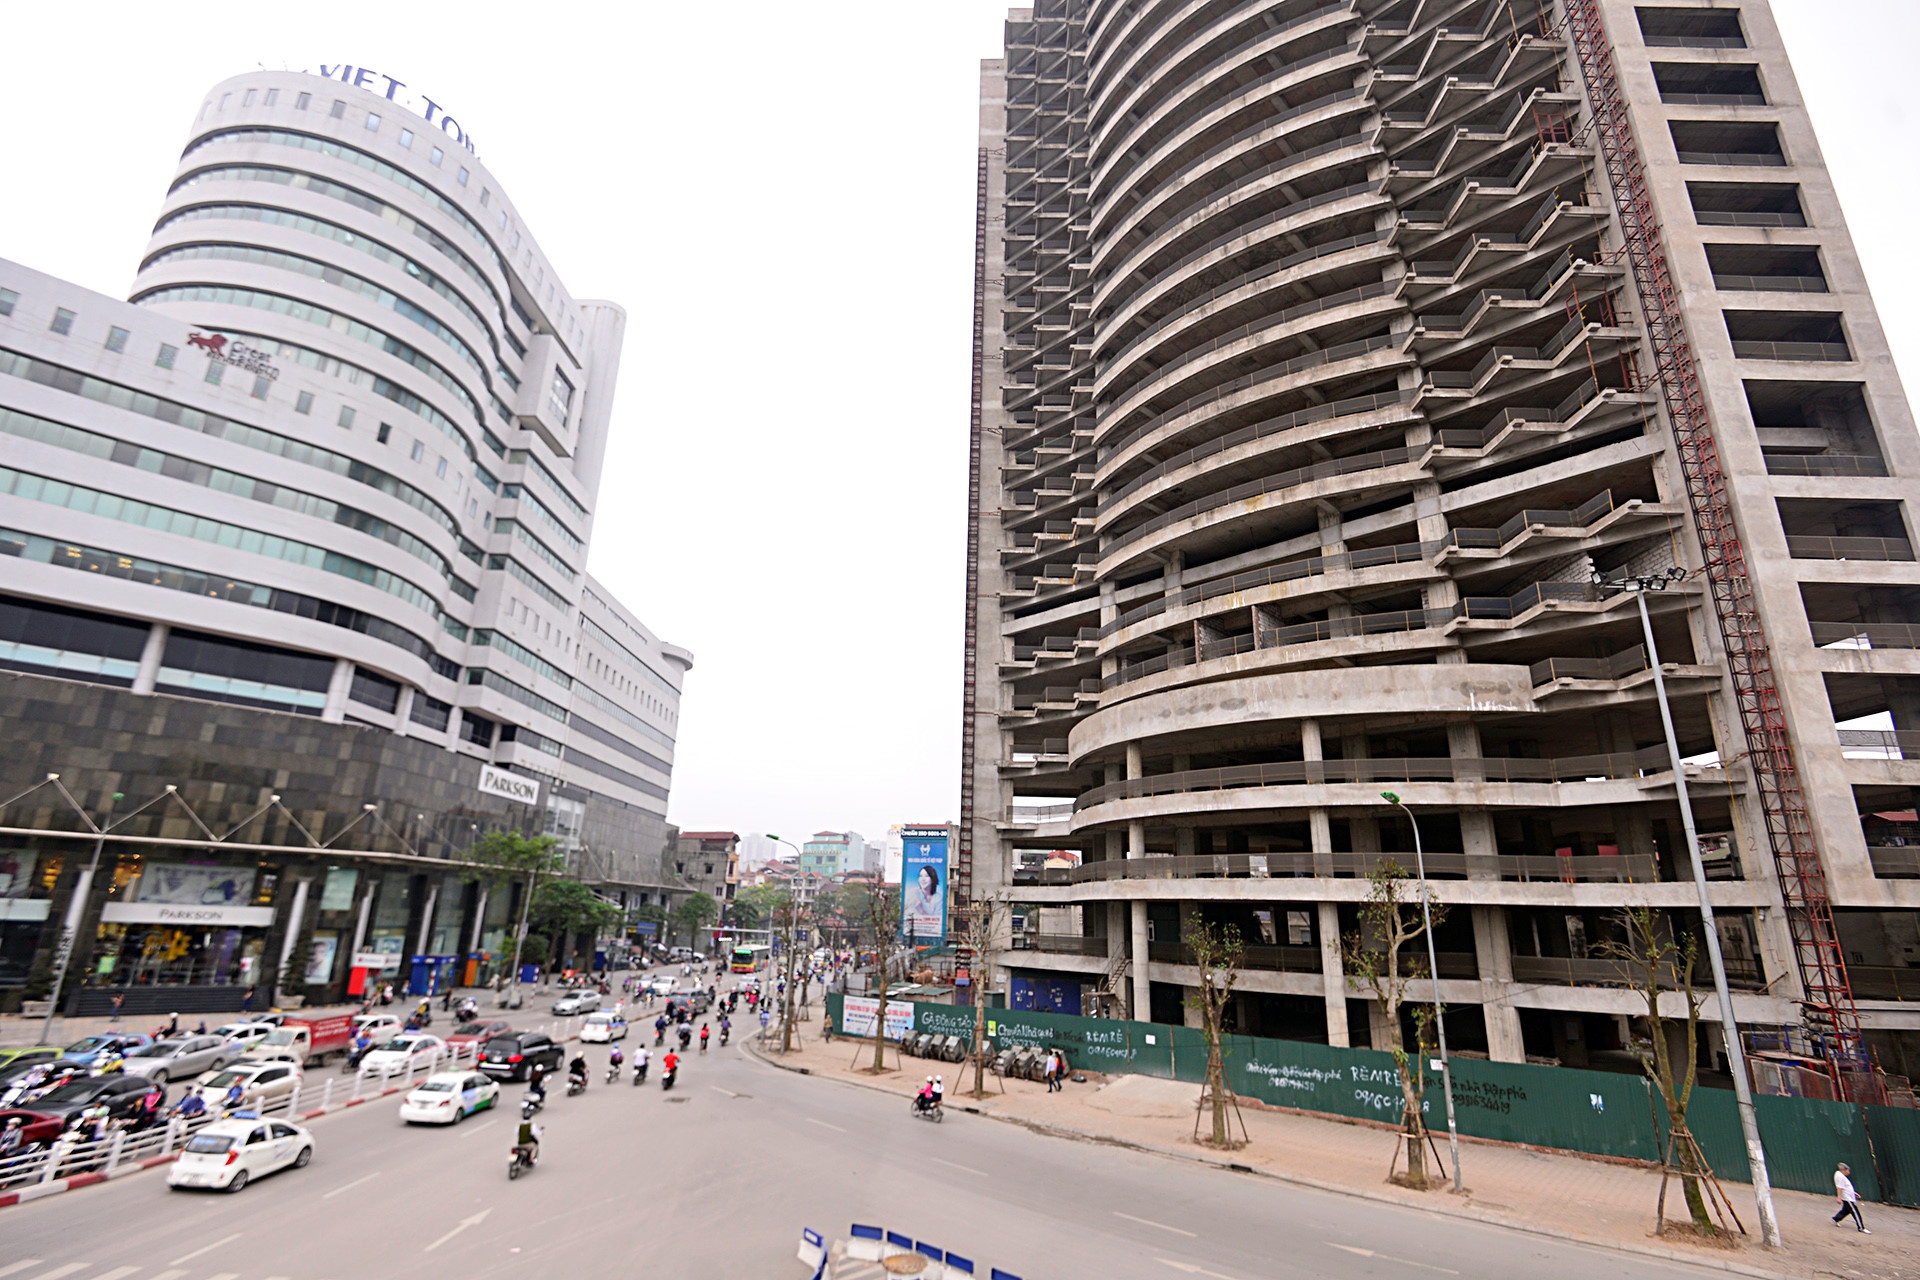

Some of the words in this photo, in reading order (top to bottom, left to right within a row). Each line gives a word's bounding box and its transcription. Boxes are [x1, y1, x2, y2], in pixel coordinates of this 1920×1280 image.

[229, 341, 272, 362] Great
[228, 353, 280, 376] Eastern
[485, 771, 535, 799] PARKSON
[160, 908, 223, 920] PARKSON
